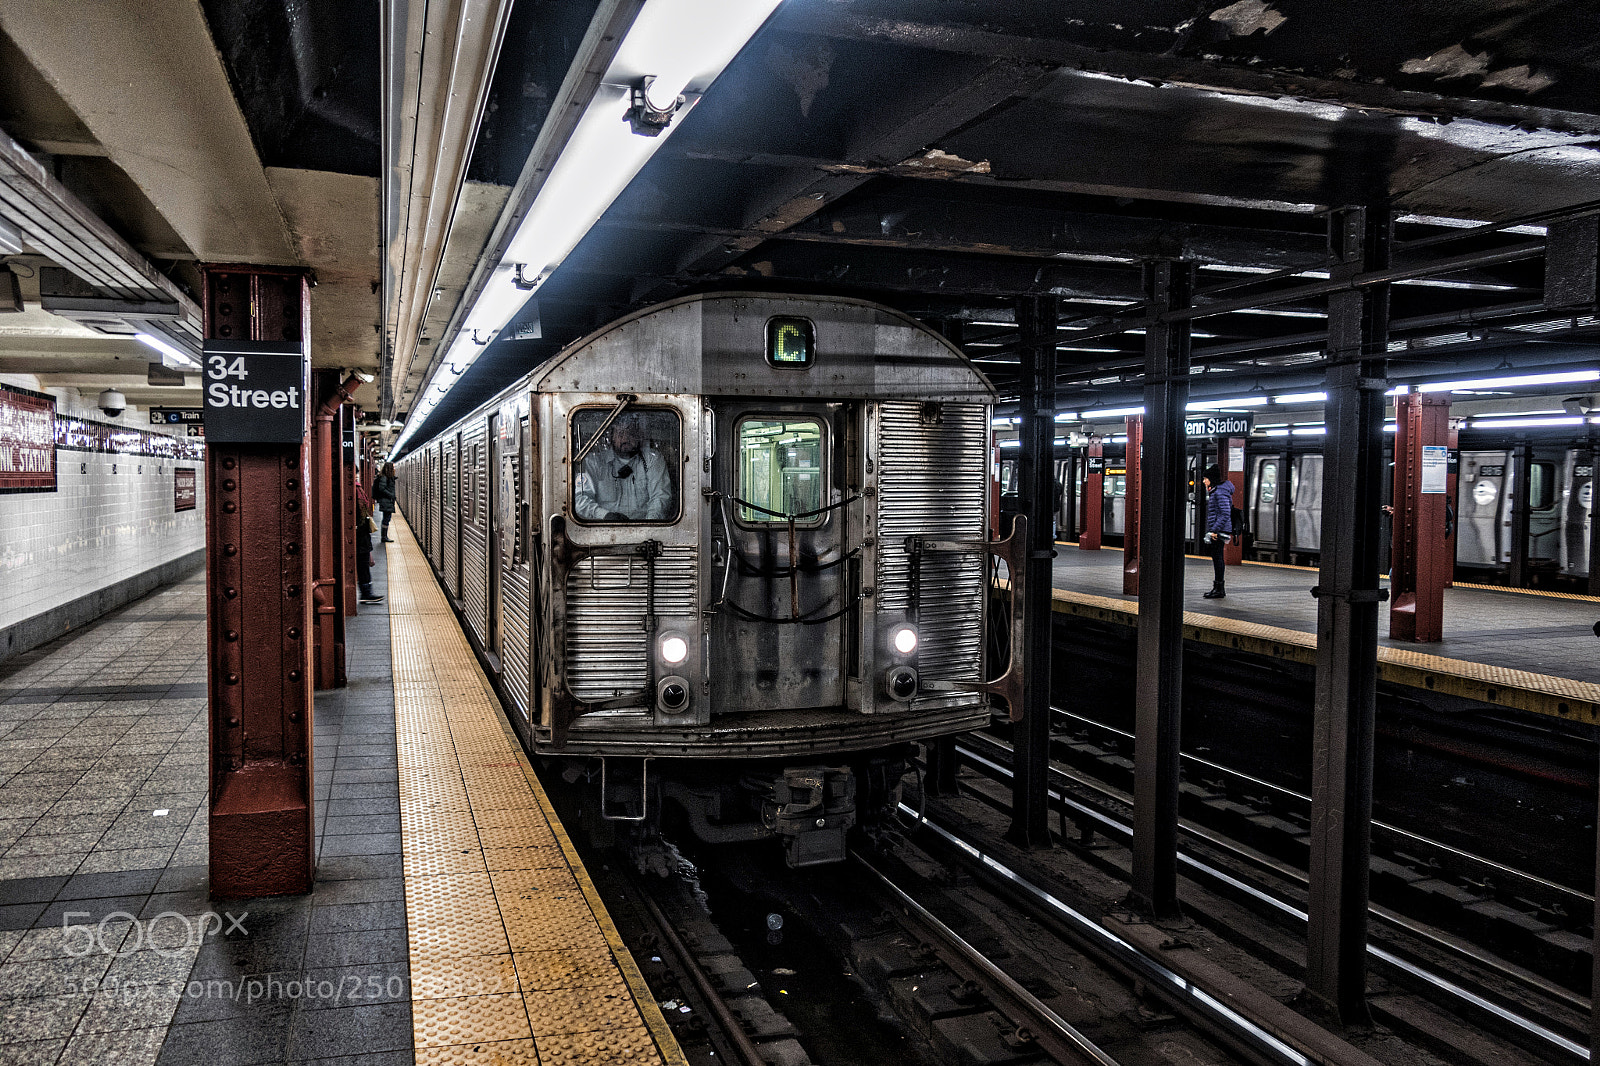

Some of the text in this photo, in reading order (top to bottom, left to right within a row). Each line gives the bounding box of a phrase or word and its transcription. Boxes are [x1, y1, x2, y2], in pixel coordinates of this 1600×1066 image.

[778, 325, 799, 362] C
[208, 355, 249, 380] 34
[208, 383, 300, 409] Street
[180, 411, 200, 420] Train
[1207, 417, 1248, 434] Station
[19, 447, 51, 473] STATION
